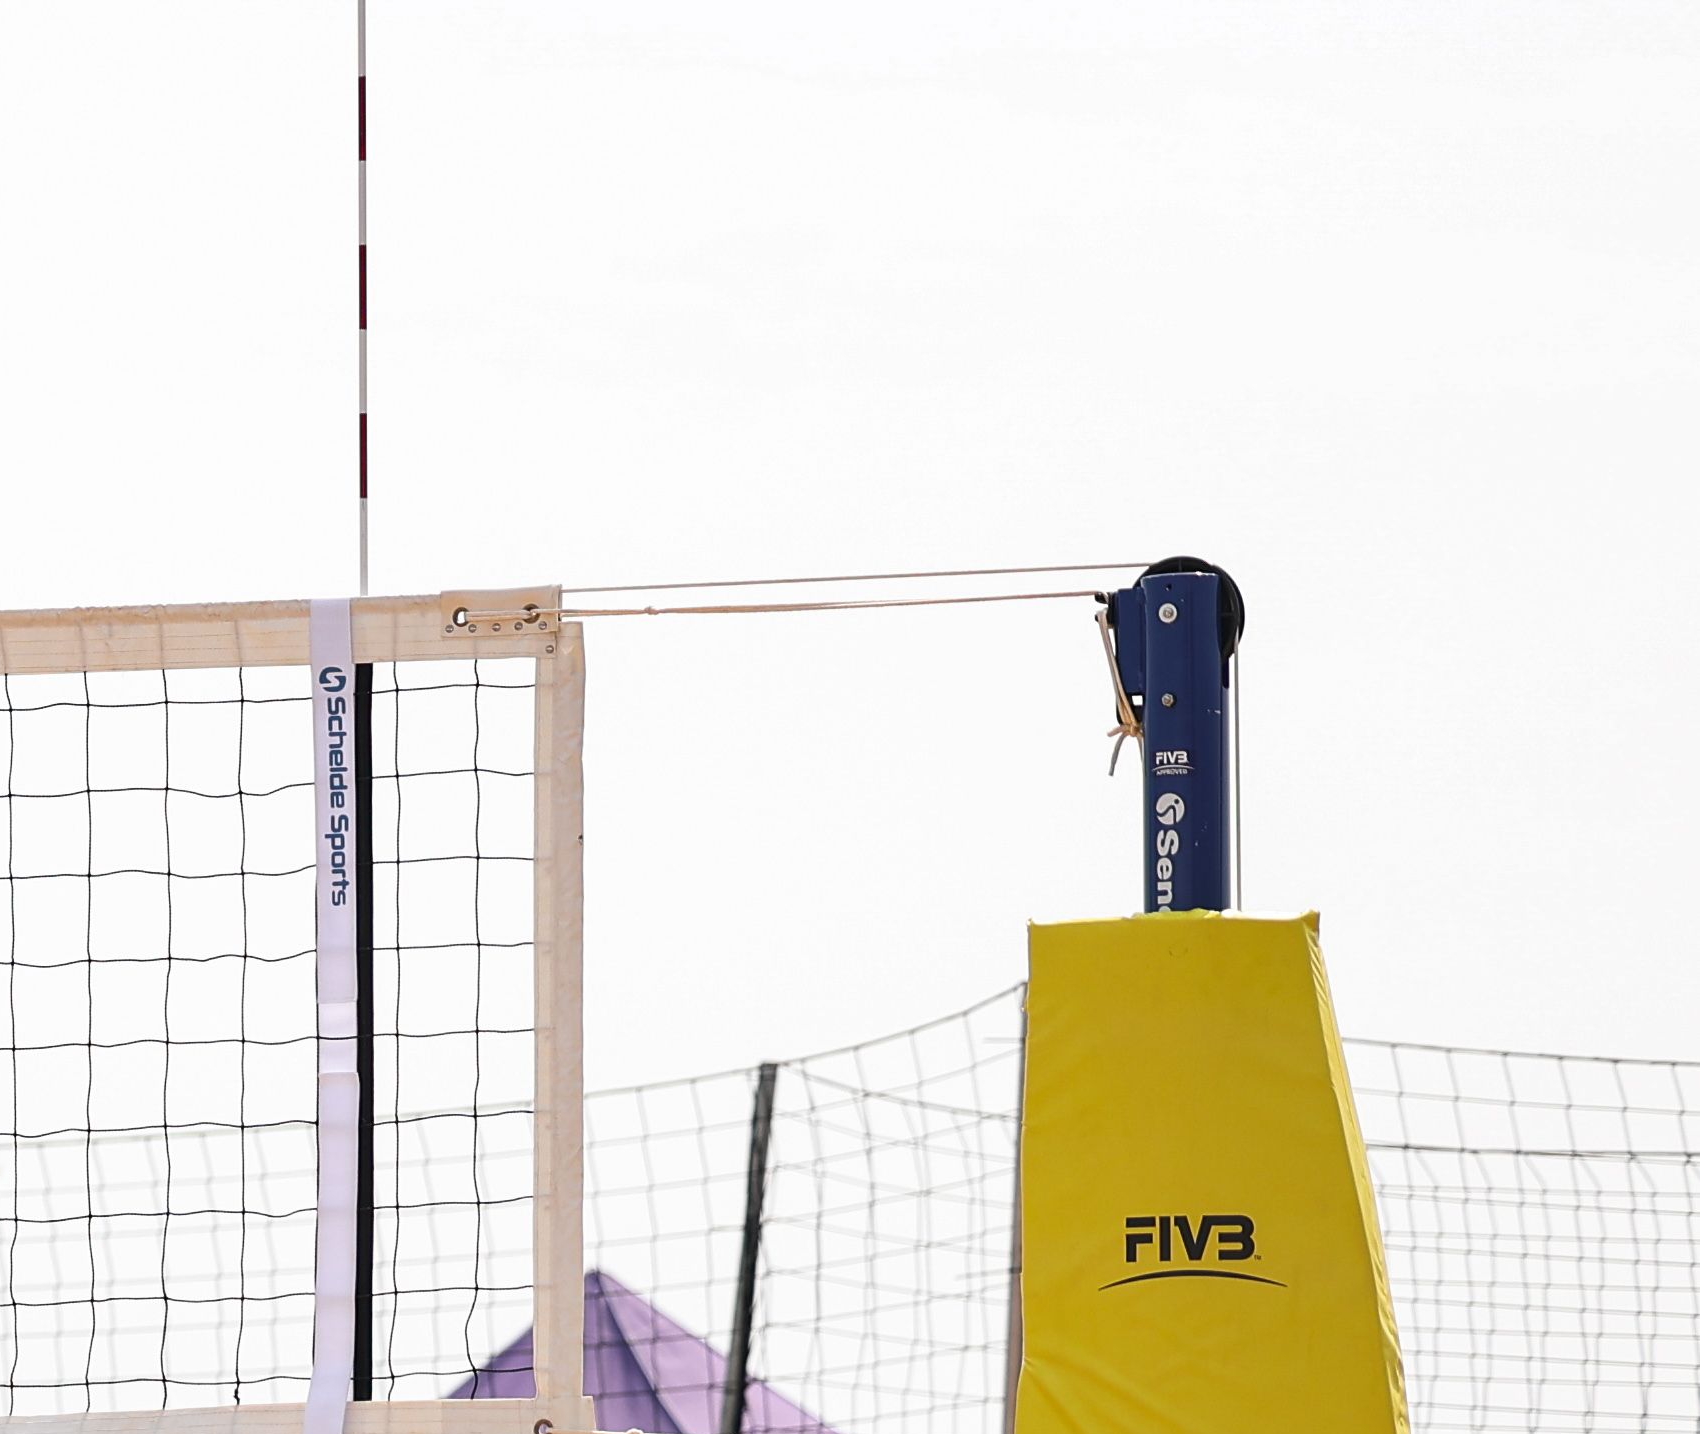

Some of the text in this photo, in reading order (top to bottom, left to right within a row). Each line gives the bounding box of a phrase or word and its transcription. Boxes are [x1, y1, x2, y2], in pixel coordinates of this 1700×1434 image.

[1155, 750, 1189, 765] FIVB
[325, 696, 350, 906] Schelde Sports
[1156, 829, 1180, 912] Sen
[1126, 1214, 1256, 1263] FIVB
